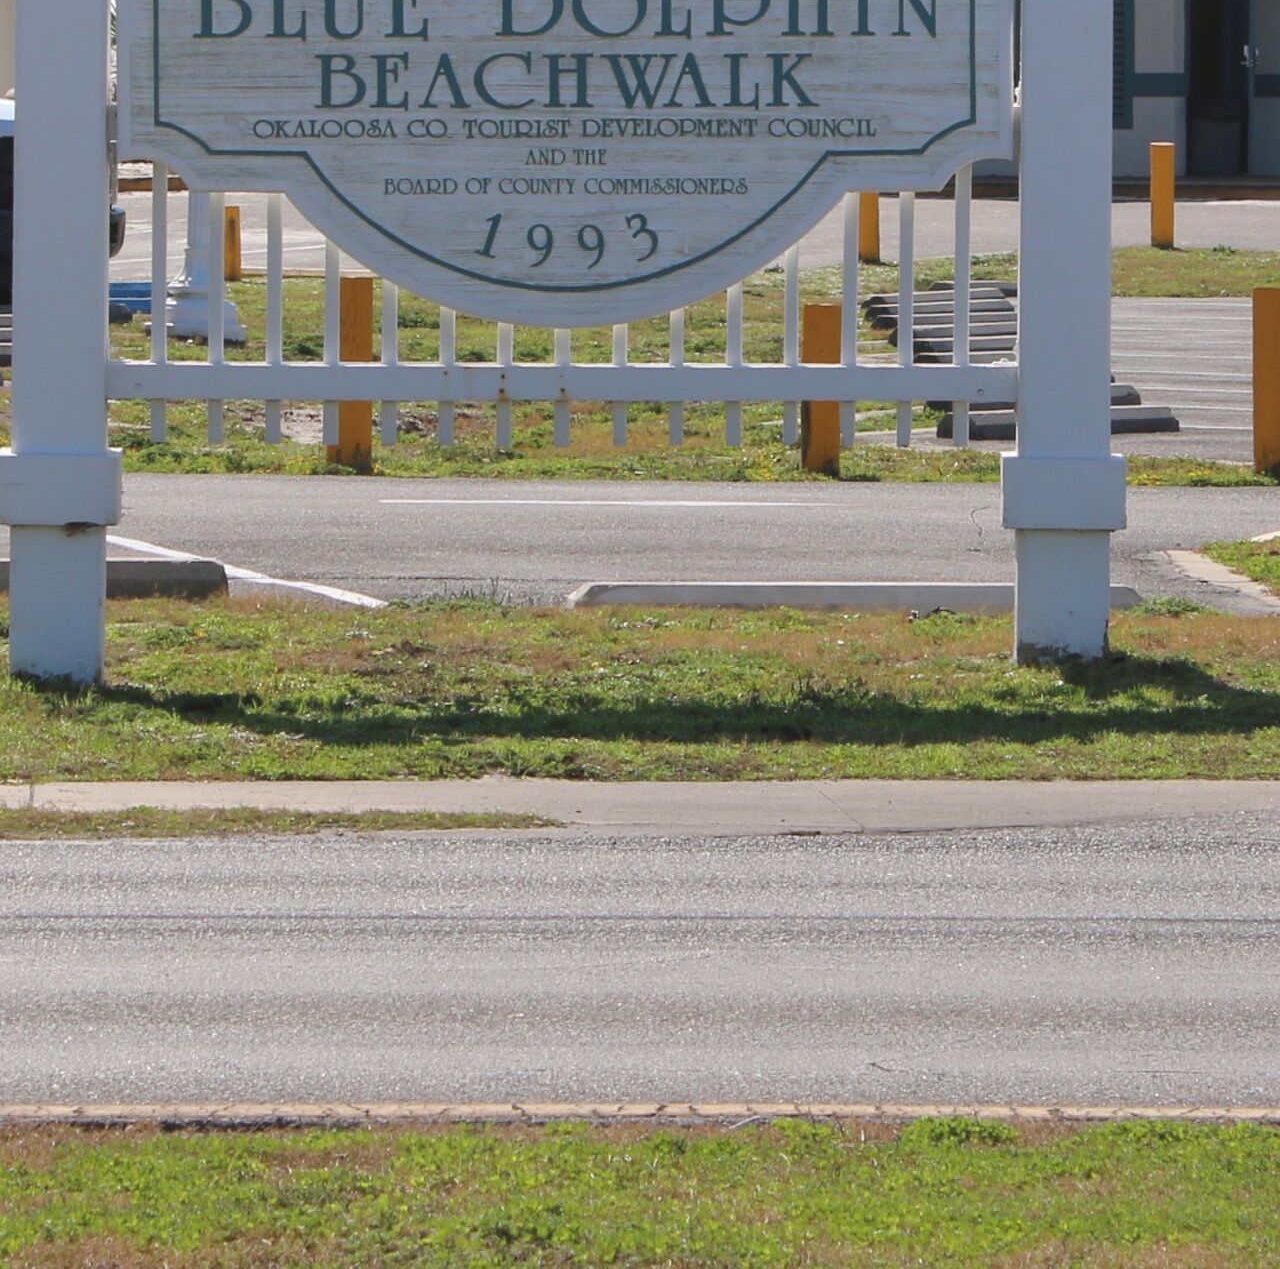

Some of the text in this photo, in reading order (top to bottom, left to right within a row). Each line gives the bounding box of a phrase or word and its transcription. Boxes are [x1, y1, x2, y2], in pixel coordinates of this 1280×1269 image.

[314, 51, 820, 111] BEACHWALK
[253, 118, 394, 139] OKALOOSA
[463, 118, 571, 139] TOURIST
[582, 118, 759, 138] DEVELOPMENT
[768, 118, 877, 138] COUNCIL
[525, 149, 607, 165] AND THE
[384, 177, 749, 195] BOARD OF COUNTY COMMISSIONERS
[474, 213, 659, 269] 1993
